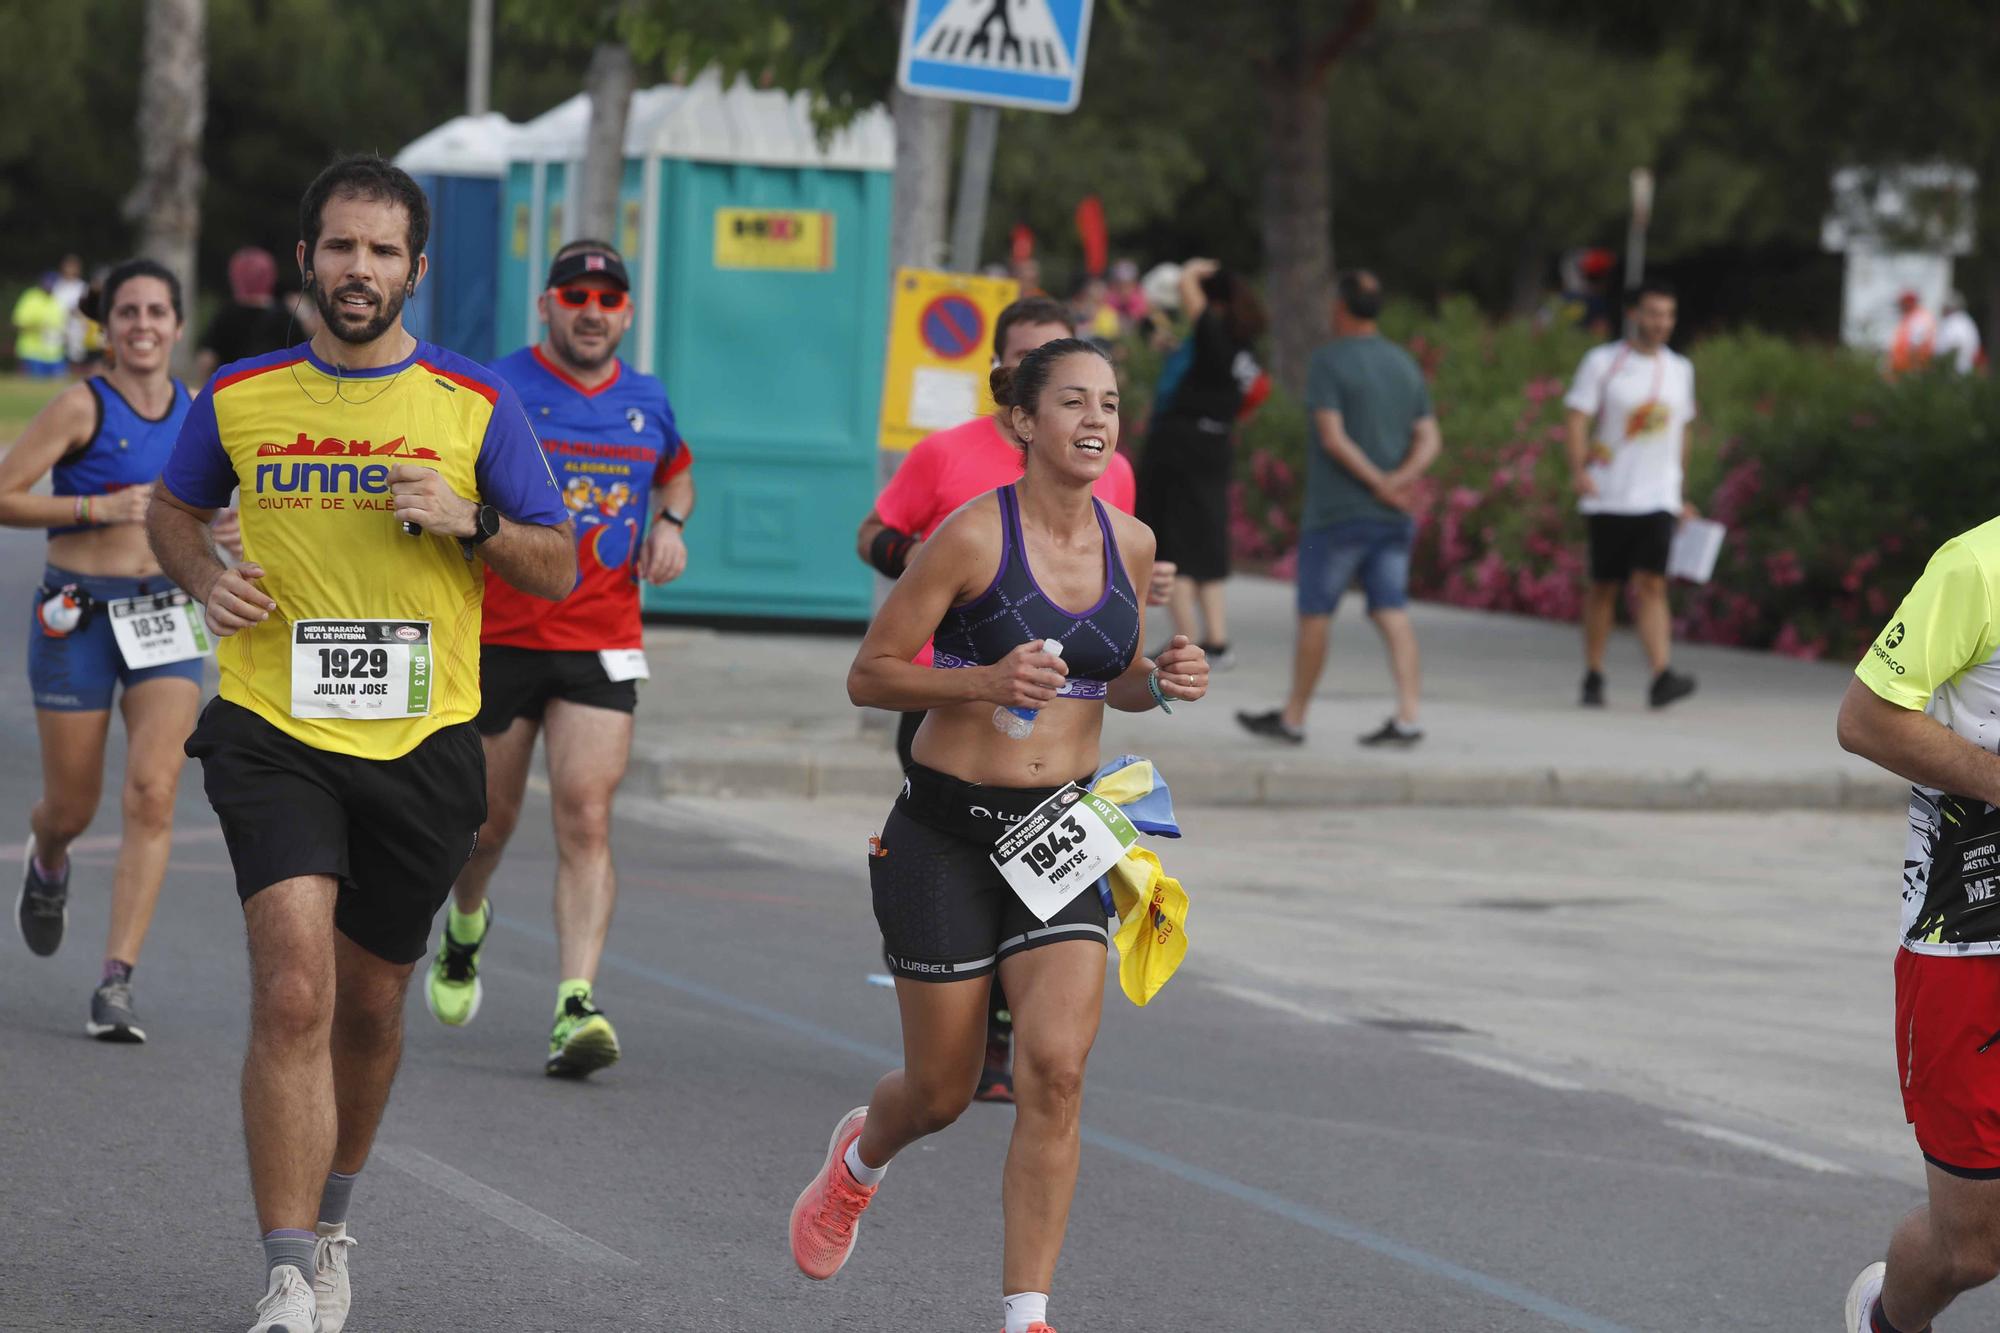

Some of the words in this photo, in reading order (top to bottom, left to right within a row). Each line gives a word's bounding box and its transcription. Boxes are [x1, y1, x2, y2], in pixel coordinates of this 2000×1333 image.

[256, 463, 392, 493] runne
[258, 497, 312, 510] CIUTAT
[321, 498, 345, 510] DE
[354, 496, 396, 511] VALÈ
[131, 613, 175, 638] 1835
[304, 625, 326, 633] MEDIA
[328, 625, 365, 633] MARATÓN
[318, 648, 388, 679] 1929
[415, 656, 426, 676] BOX
[313, 684, 355, 695] JULIAN
[359, 684, 388, 695] JOSE
[414, 679, 425, 687] 3
[1092, 799, 1111, 816] BOX
[1109, 815, 1119, 824] 3
[1015, 813, 1045, 838] MARATÓN
[1001, 845, 1016, 859] VILA
[1015, 839, 1026, 849] DE
[1024, 818, 1050, 842] PATERNA
[1020, 815, 1087, 877] 1943
[1963, 844, 1996, 861] CONTIGO
[1048, 849, 1088, 884] MONTSE
[901, 958, 952, 974] LURBEL
